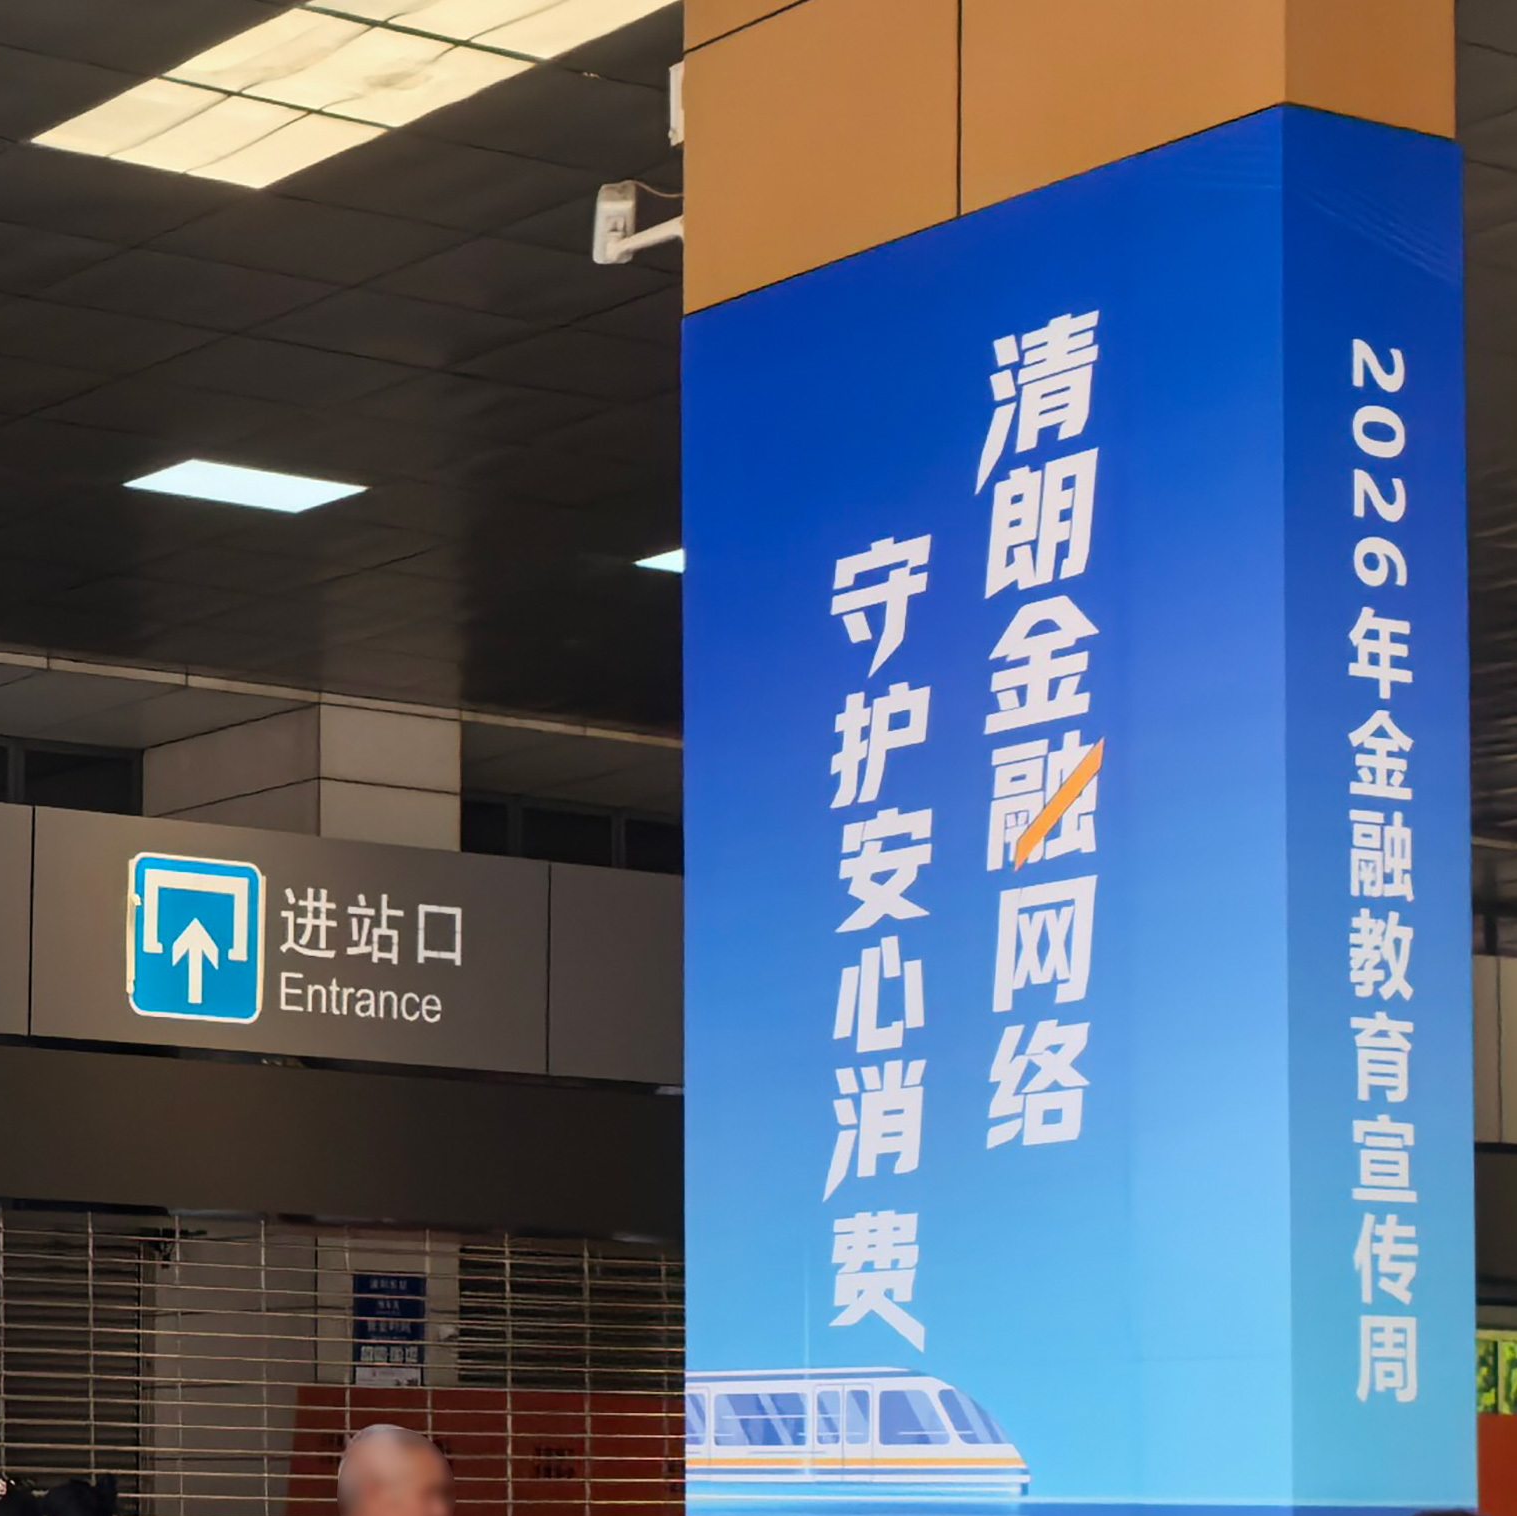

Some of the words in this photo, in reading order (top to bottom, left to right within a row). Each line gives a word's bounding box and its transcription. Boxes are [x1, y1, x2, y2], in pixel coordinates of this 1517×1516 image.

[279, 972, 443, 1023] Entrance
[280, 887, 463, 967] 进站口
[823, 534, 933, 1352] 守护安心消费
[974, 309, 1106, 1149] 清朗金融网络
[1347, 338, 1419, 1404] 2026年金融教育宣传周
